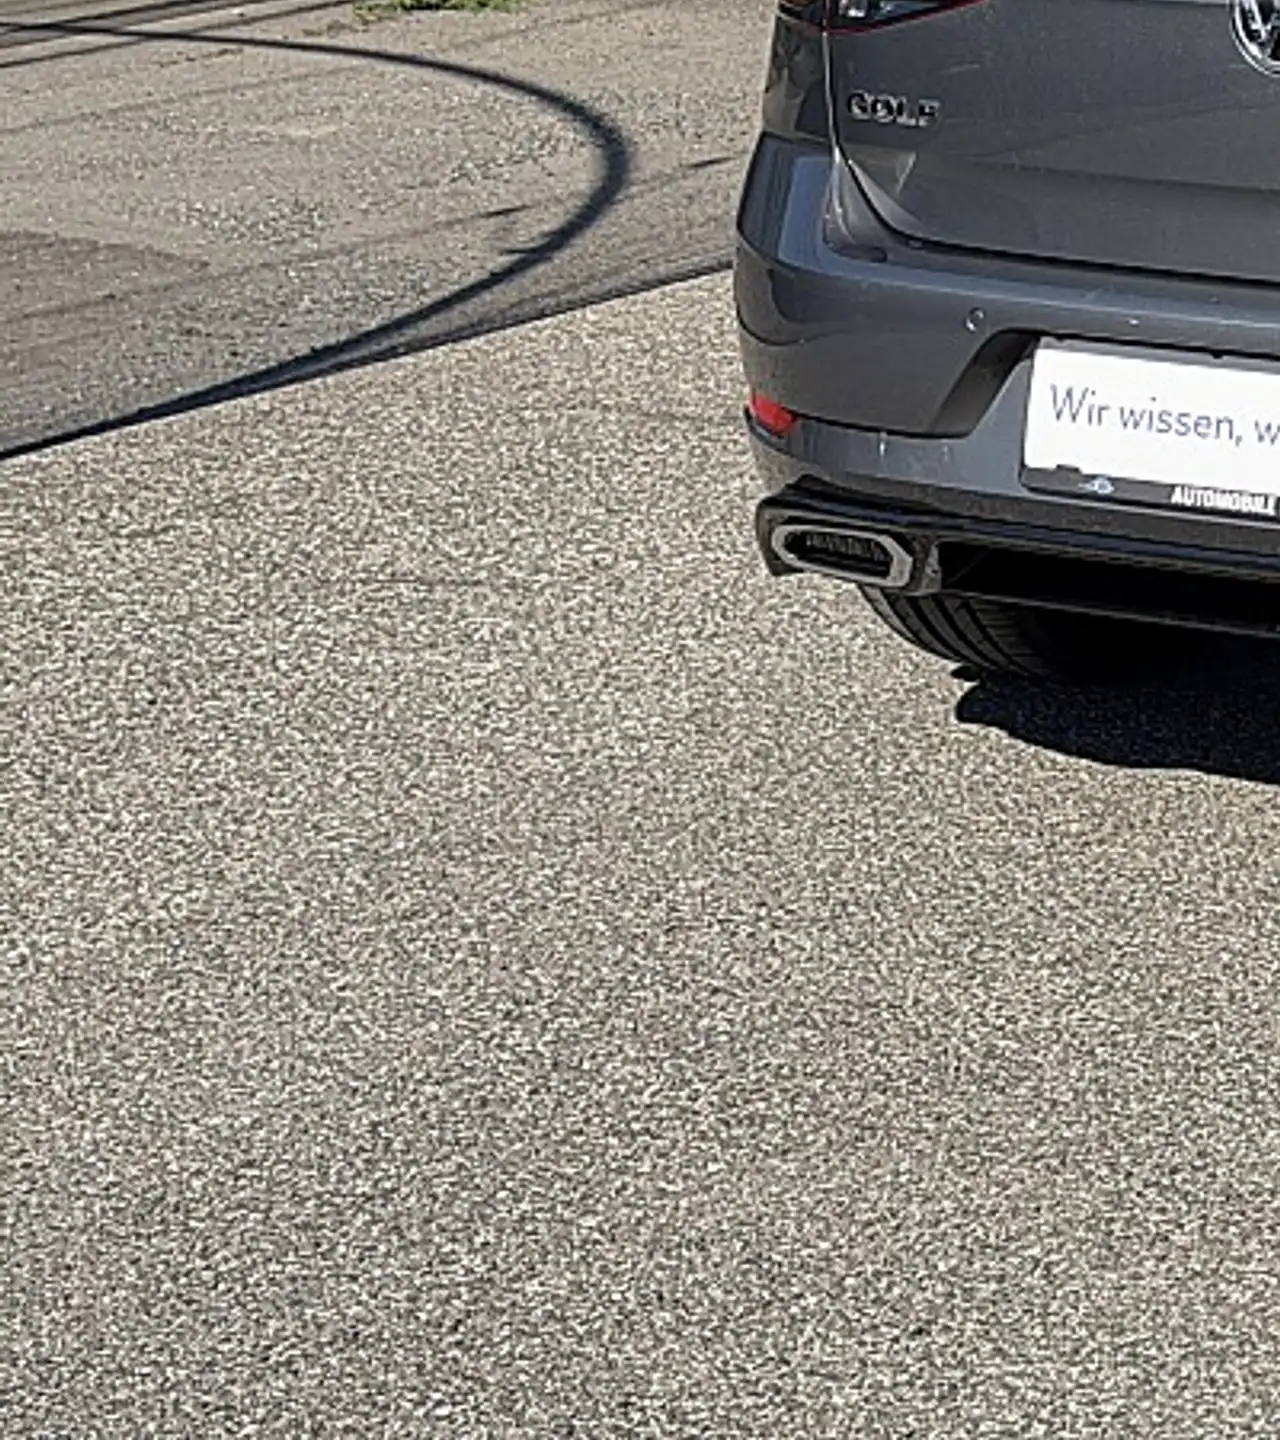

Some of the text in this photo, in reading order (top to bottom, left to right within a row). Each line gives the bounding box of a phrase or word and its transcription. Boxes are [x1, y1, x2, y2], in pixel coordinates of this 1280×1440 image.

[848, 90, 941, 127] GOLF
[1049, 384, 1110, 427] Wir
[1117, 396, 1243, 447] wissen,
[1170, 485, 1277, 517] AUTOMOBILE
